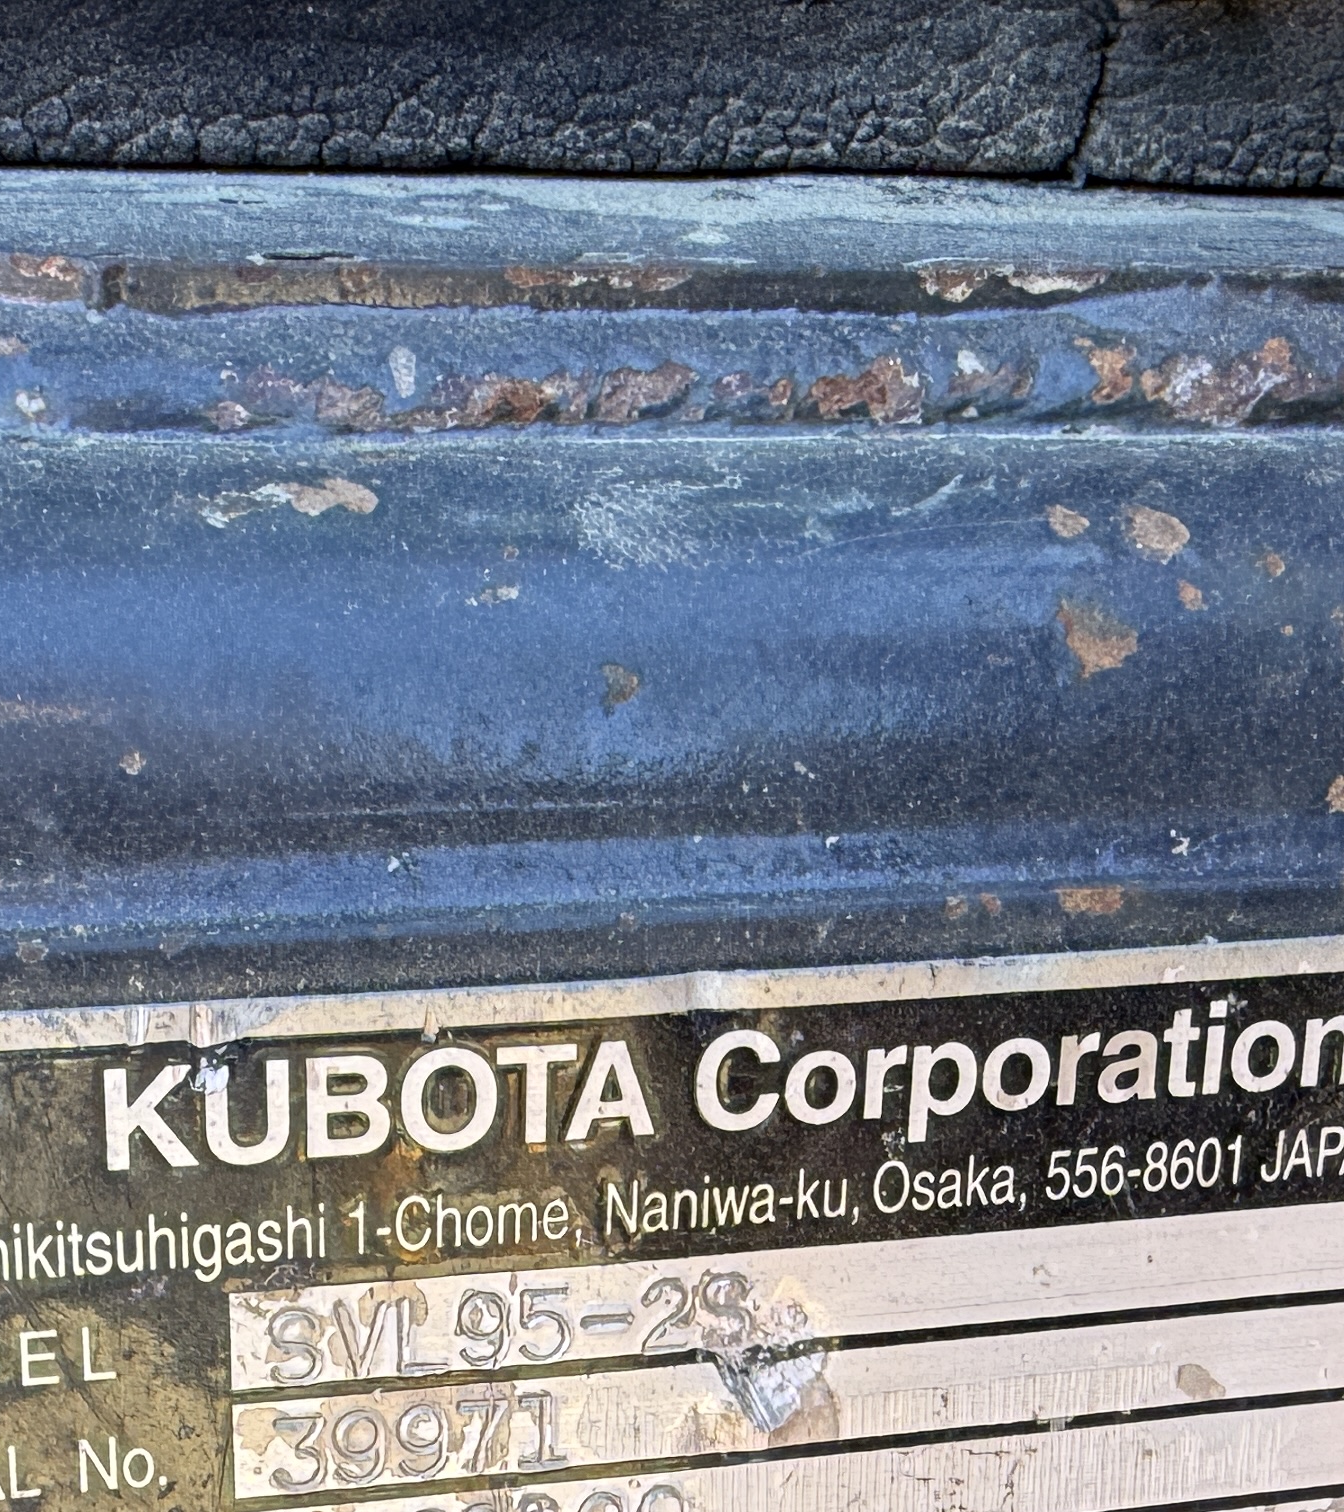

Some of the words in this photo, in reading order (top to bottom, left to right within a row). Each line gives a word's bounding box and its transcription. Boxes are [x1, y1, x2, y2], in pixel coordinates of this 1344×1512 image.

[103, 1038, 654, 1172] KUBOTA
[350, 1192, 583, 1255] 1-Chome,
[606, 1171, 861, 1236] Naniwa-ku,
[873, 1158, 1028, 1213] Osaka,
[1045, 1138, 1244, 1200] 556-8601
[78, 1436, 169, 1493] No.
[268, 1390, 568, 1492] 39971
